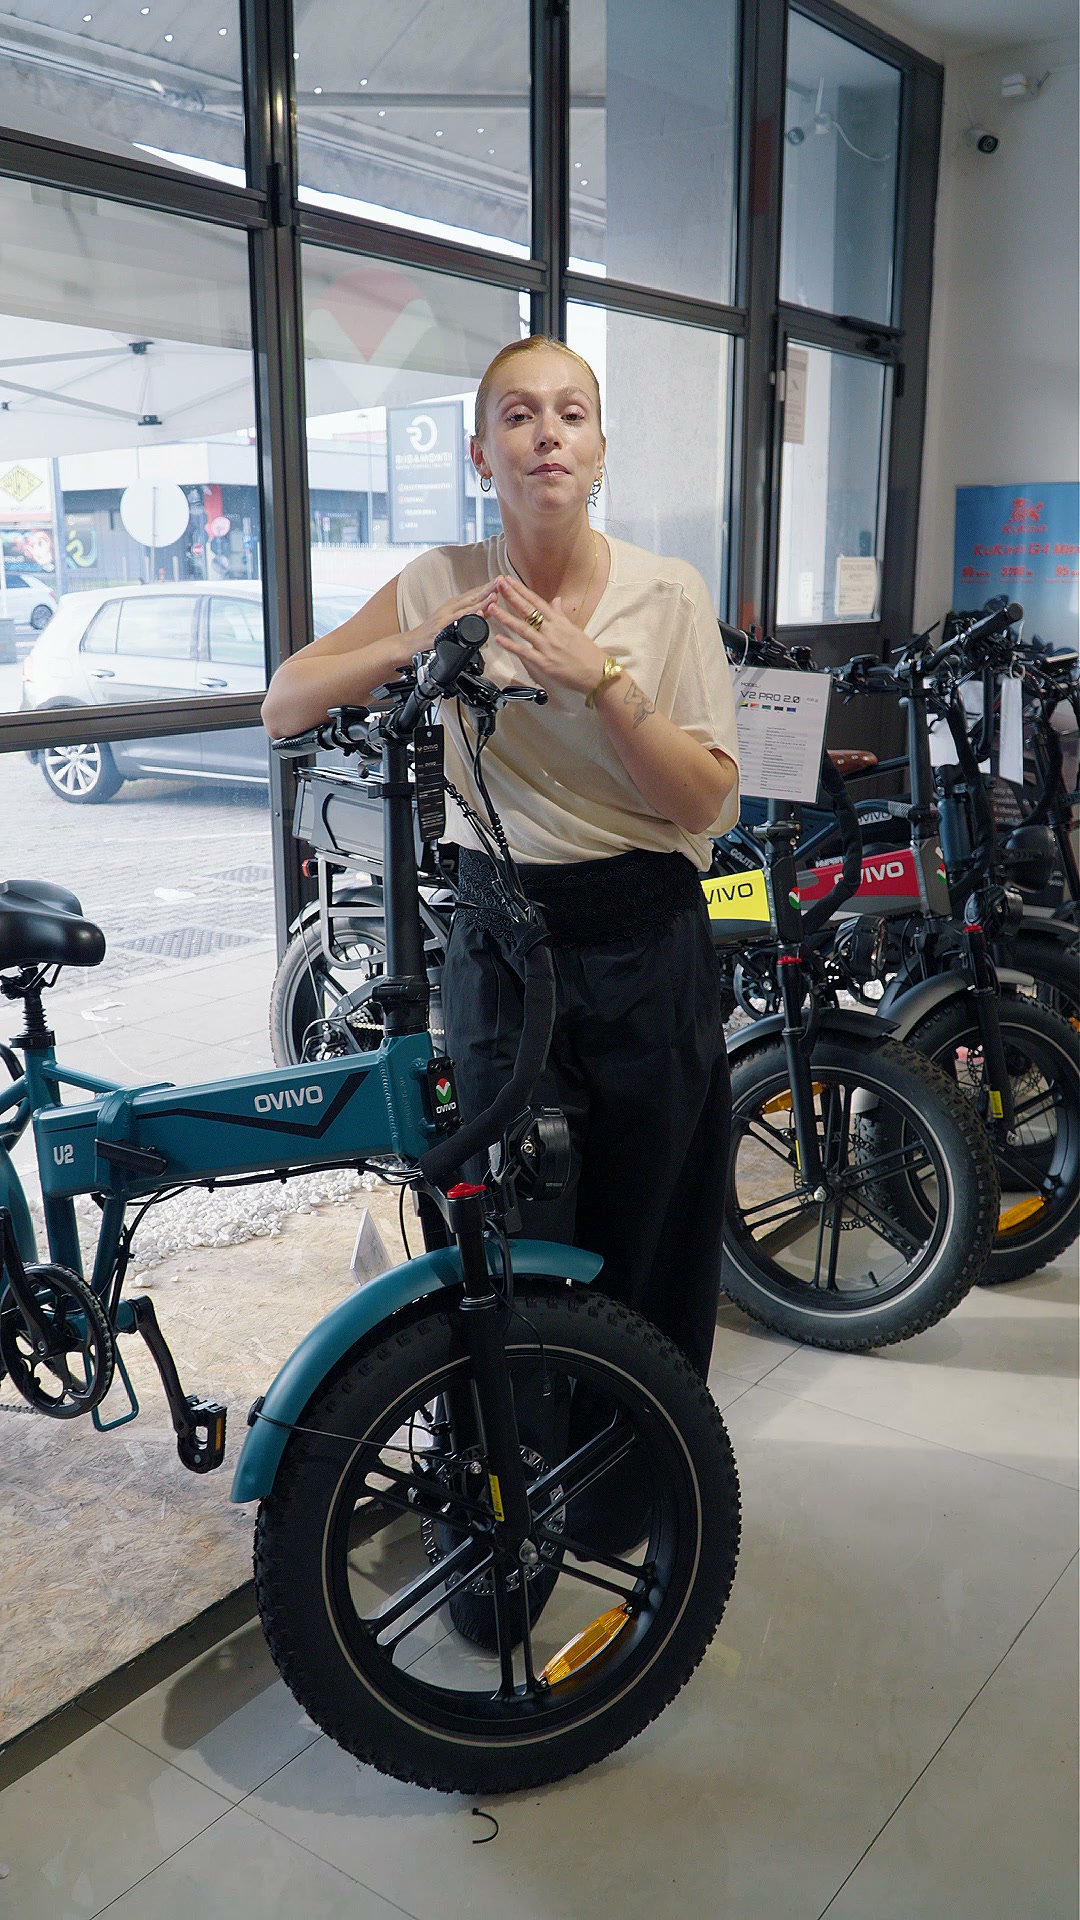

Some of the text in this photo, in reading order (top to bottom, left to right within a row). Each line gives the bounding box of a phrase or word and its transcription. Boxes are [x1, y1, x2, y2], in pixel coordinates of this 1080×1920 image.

[739, 690, 757, 700] V2
[758, 692, 781, 702] PRO
[782, 694, 801, 704] 2.0
[730, 848, 756, 869] GOLITE
[254, 1084, 324, 1114] OVIVO
[436, 1101, 457, 1114] OVIVO
